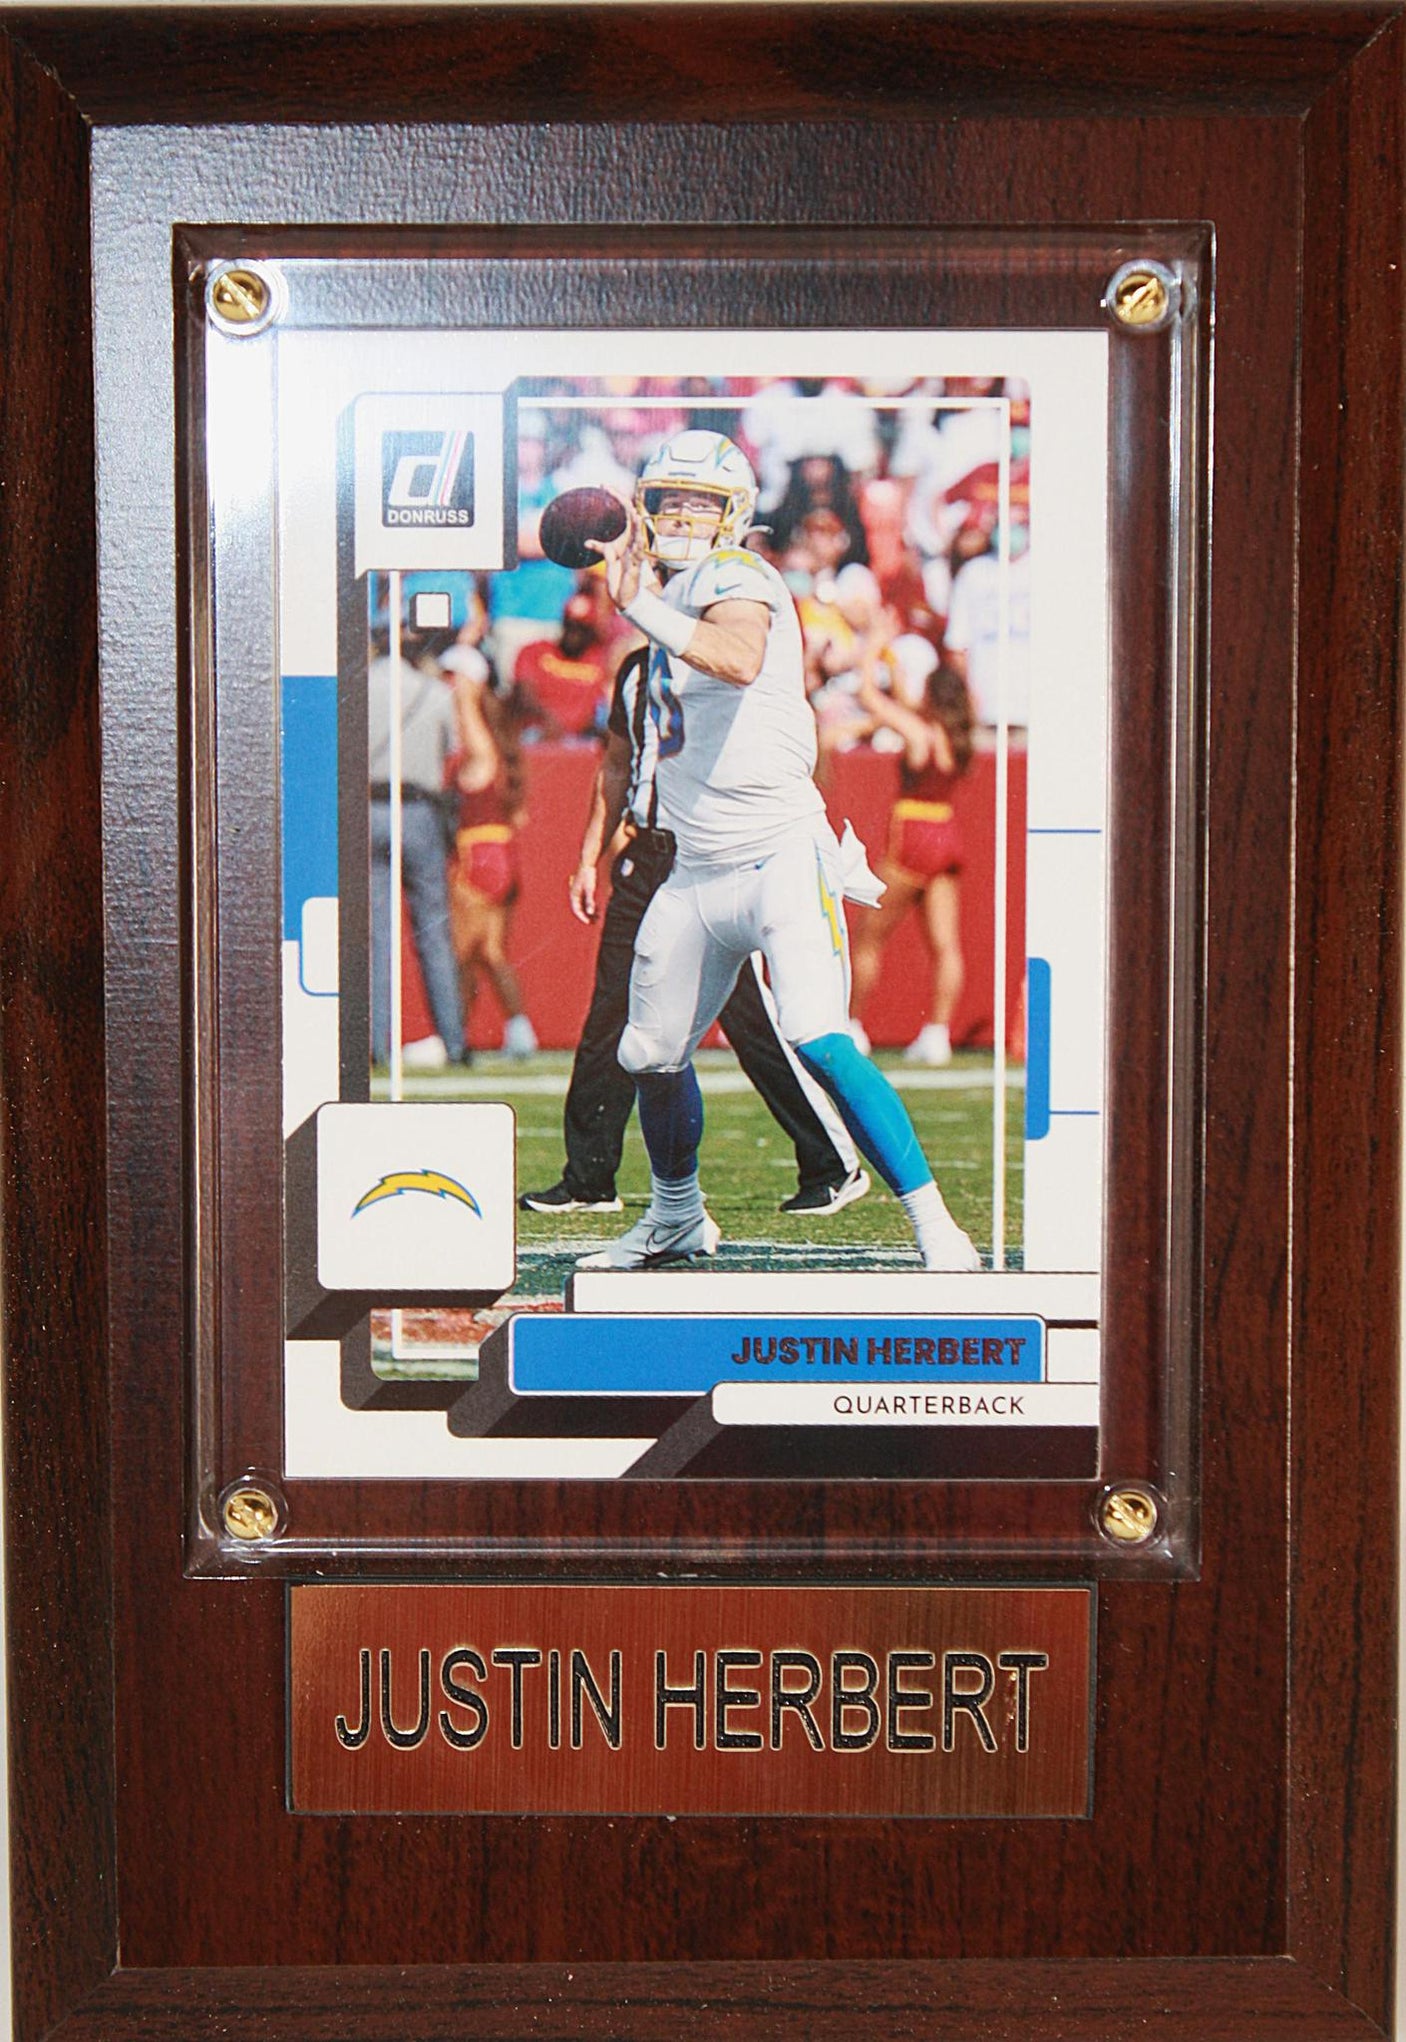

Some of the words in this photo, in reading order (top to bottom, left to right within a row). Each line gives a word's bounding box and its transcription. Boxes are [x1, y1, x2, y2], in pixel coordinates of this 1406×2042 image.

[387, 508, 470, 525] DONRUSS
[731, 1336, 859, 1366] JUSTIN
[867, 1337, 1027, 1367] HERBERT
[833, 1395, 1026, 1416] QUARTERBACK
[334, 1646, 623, 1753] JUSTIN
[654, 1647, 1051, 1755] HERBERT
